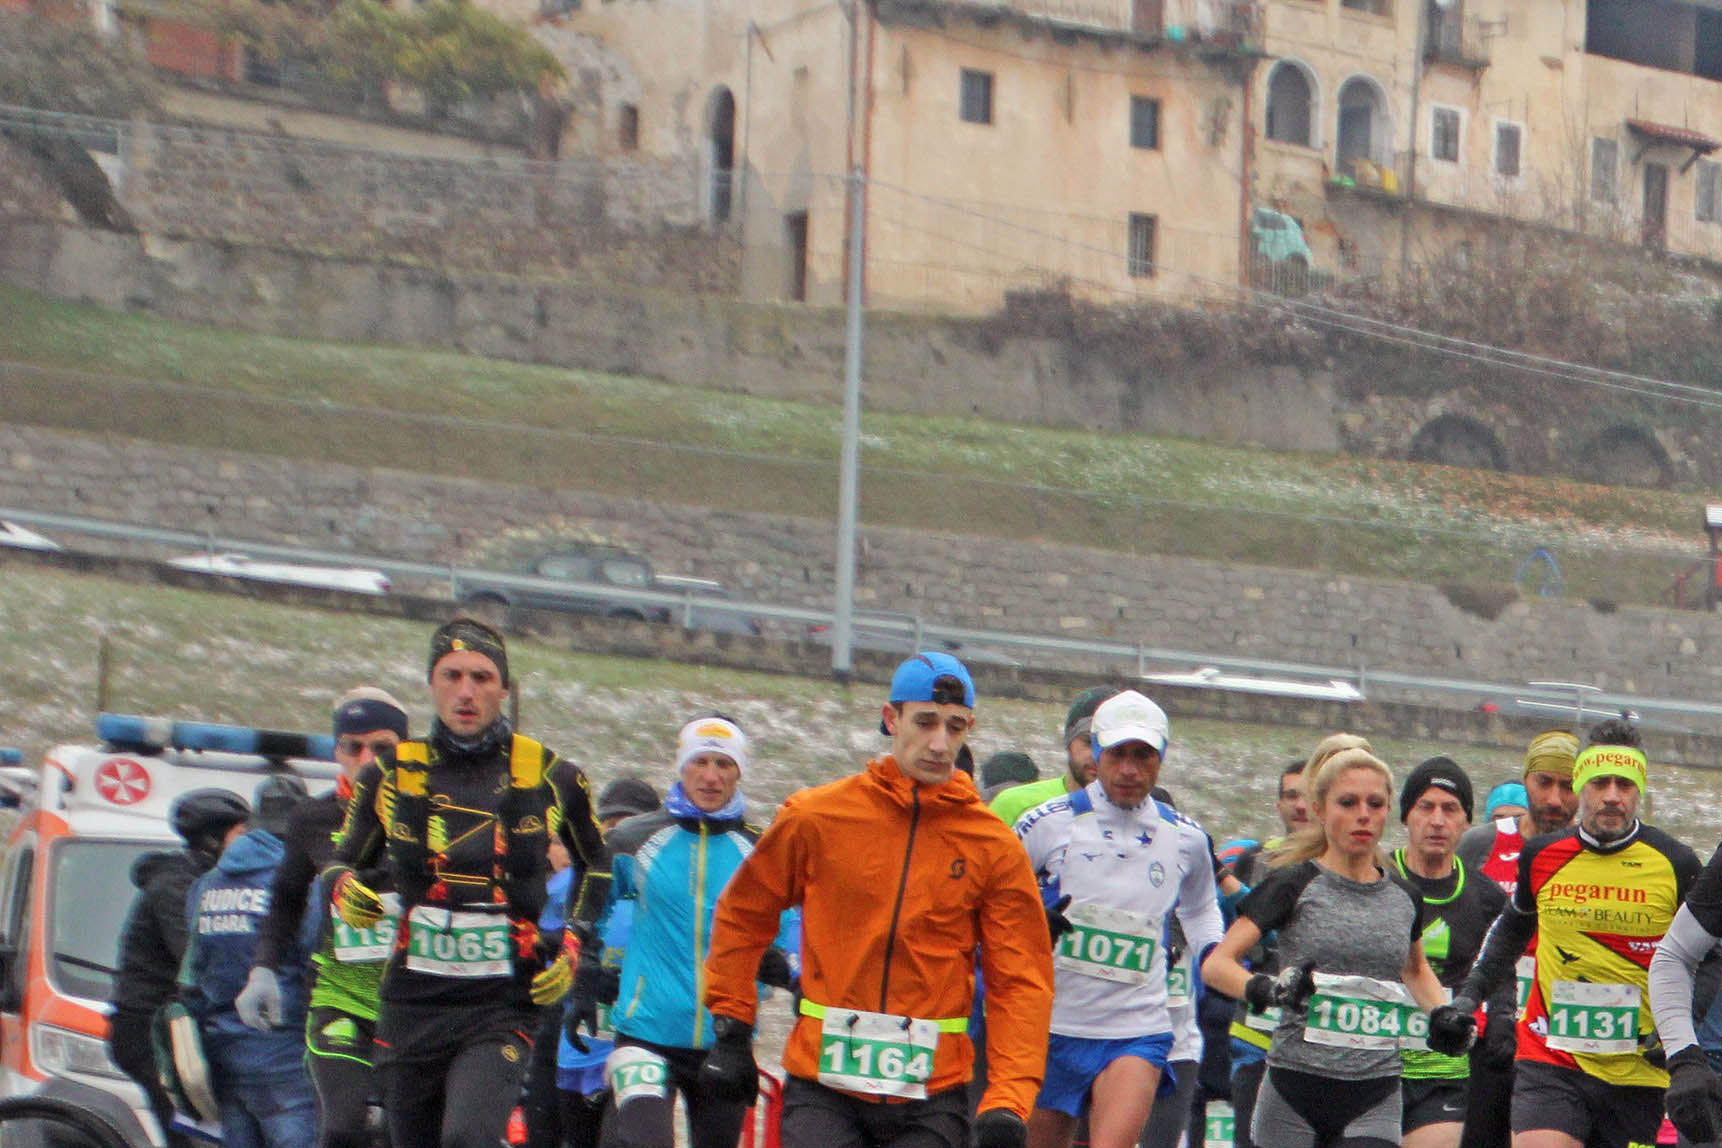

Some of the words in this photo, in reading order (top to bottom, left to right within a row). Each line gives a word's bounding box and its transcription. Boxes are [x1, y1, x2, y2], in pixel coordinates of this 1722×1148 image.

[1550, 882, 1647, 904] pegarun
[1594, 908, 1654, 925] BEAUTY
[412, 929, 507, 961] 1065
[1066, 930, 1151, 971] 1071
[1314, 1000, 1400, 1035] 1084
[1553, 1008, 1633, 1039] 1131
[823, 1040, 930, 1082] 1164
